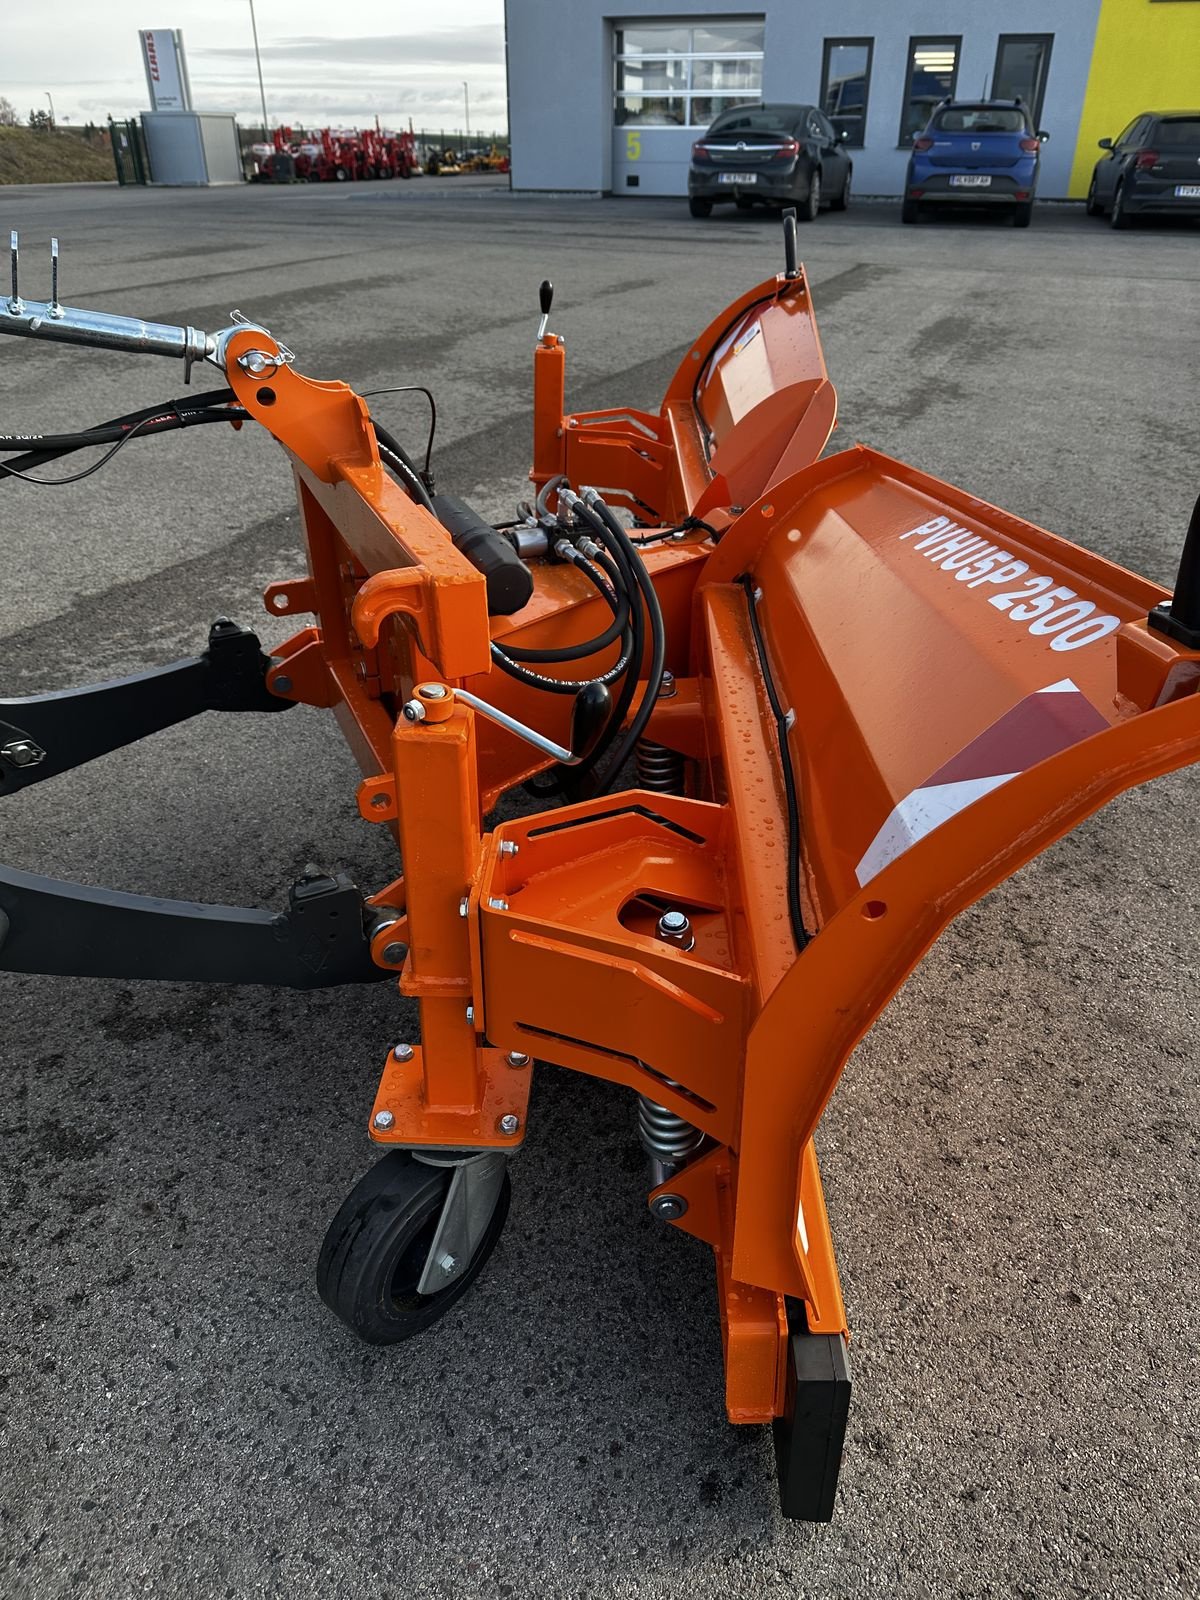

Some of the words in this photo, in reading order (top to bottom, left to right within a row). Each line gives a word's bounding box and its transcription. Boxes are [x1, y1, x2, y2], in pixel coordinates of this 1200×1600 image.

[146, 31, 160, 82] CLAAS
[627, 131, 641, 160] 5
[899, 515, 1030, 588] PVHU5P
[987, 576, 1121, 652] 2500
